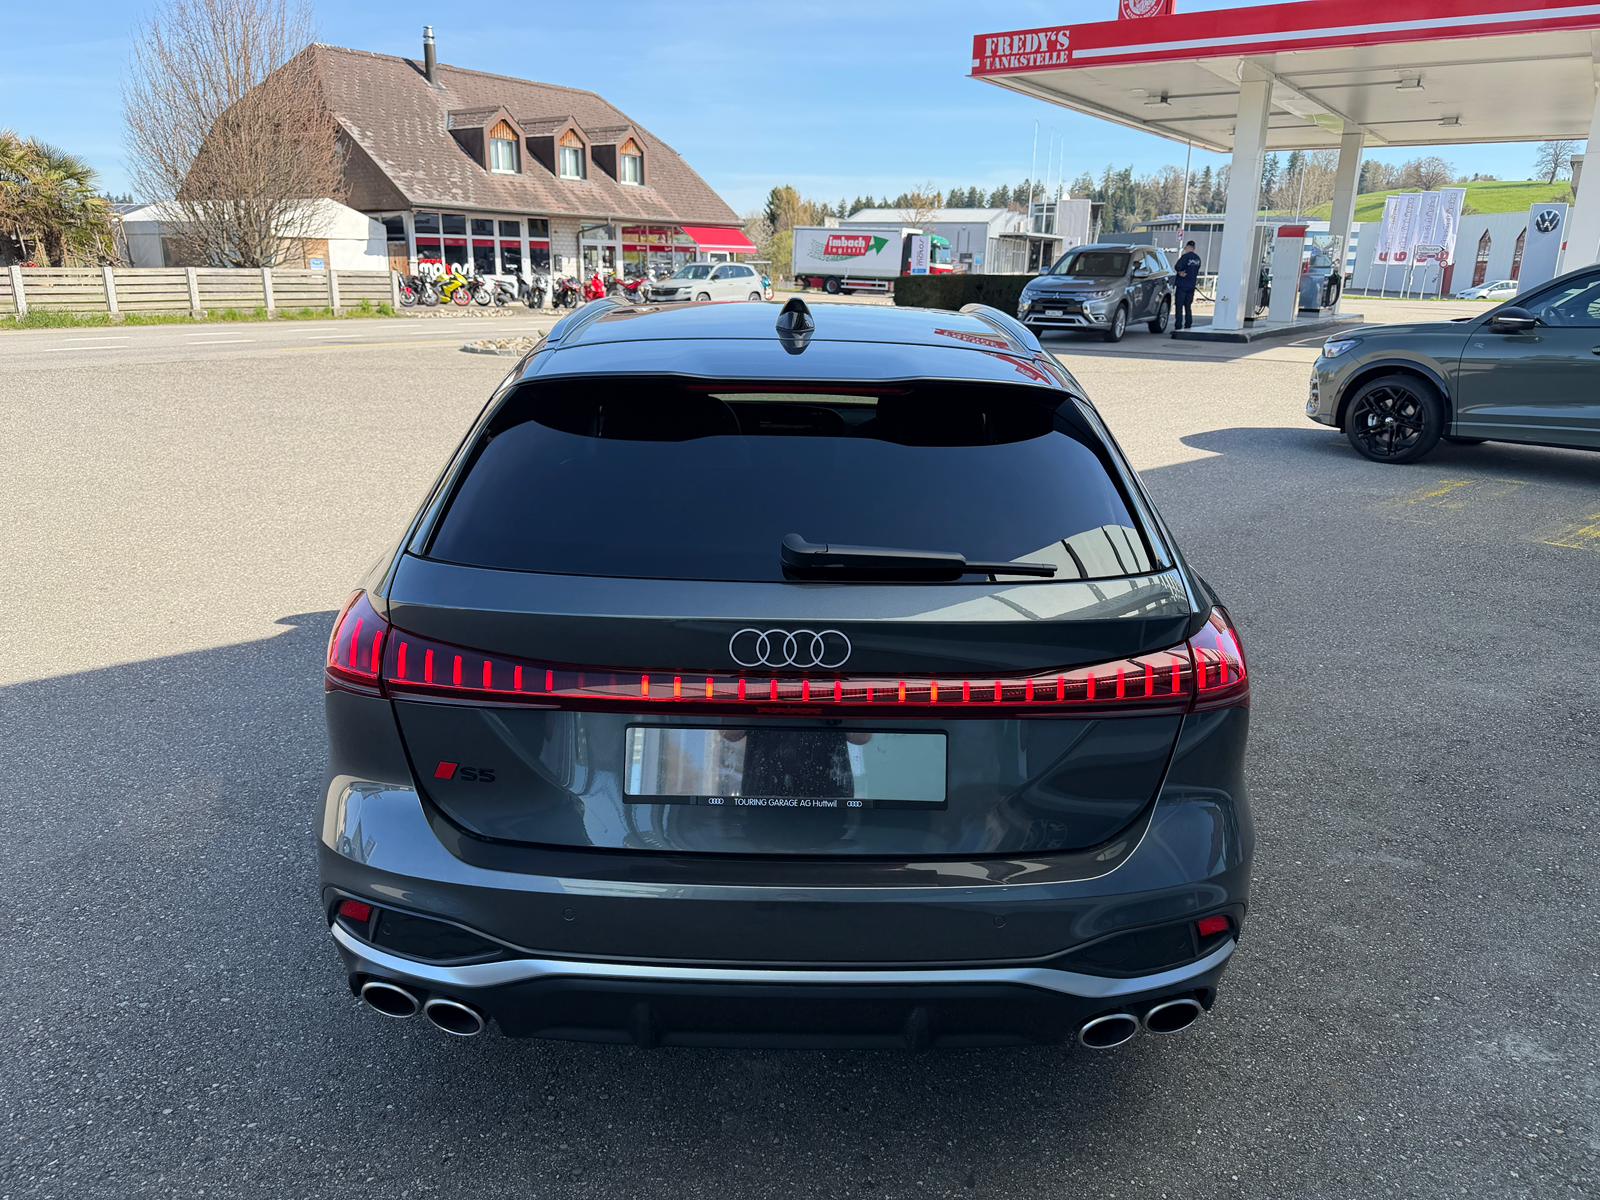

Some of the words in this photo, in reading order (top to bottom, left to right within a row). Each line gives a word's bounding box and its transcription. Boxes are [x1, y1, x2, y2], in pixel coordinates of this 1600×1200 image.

[984, 50, 1069, 70] TANKSTELLE
[460, 767, 496, 782] S5
[734, 798, 767, 807] TOURING
[768, 799, 799, 808] GARAGE
[800, 800, 812, 808] AG
[812, 800, 838, 808] Huttwil
